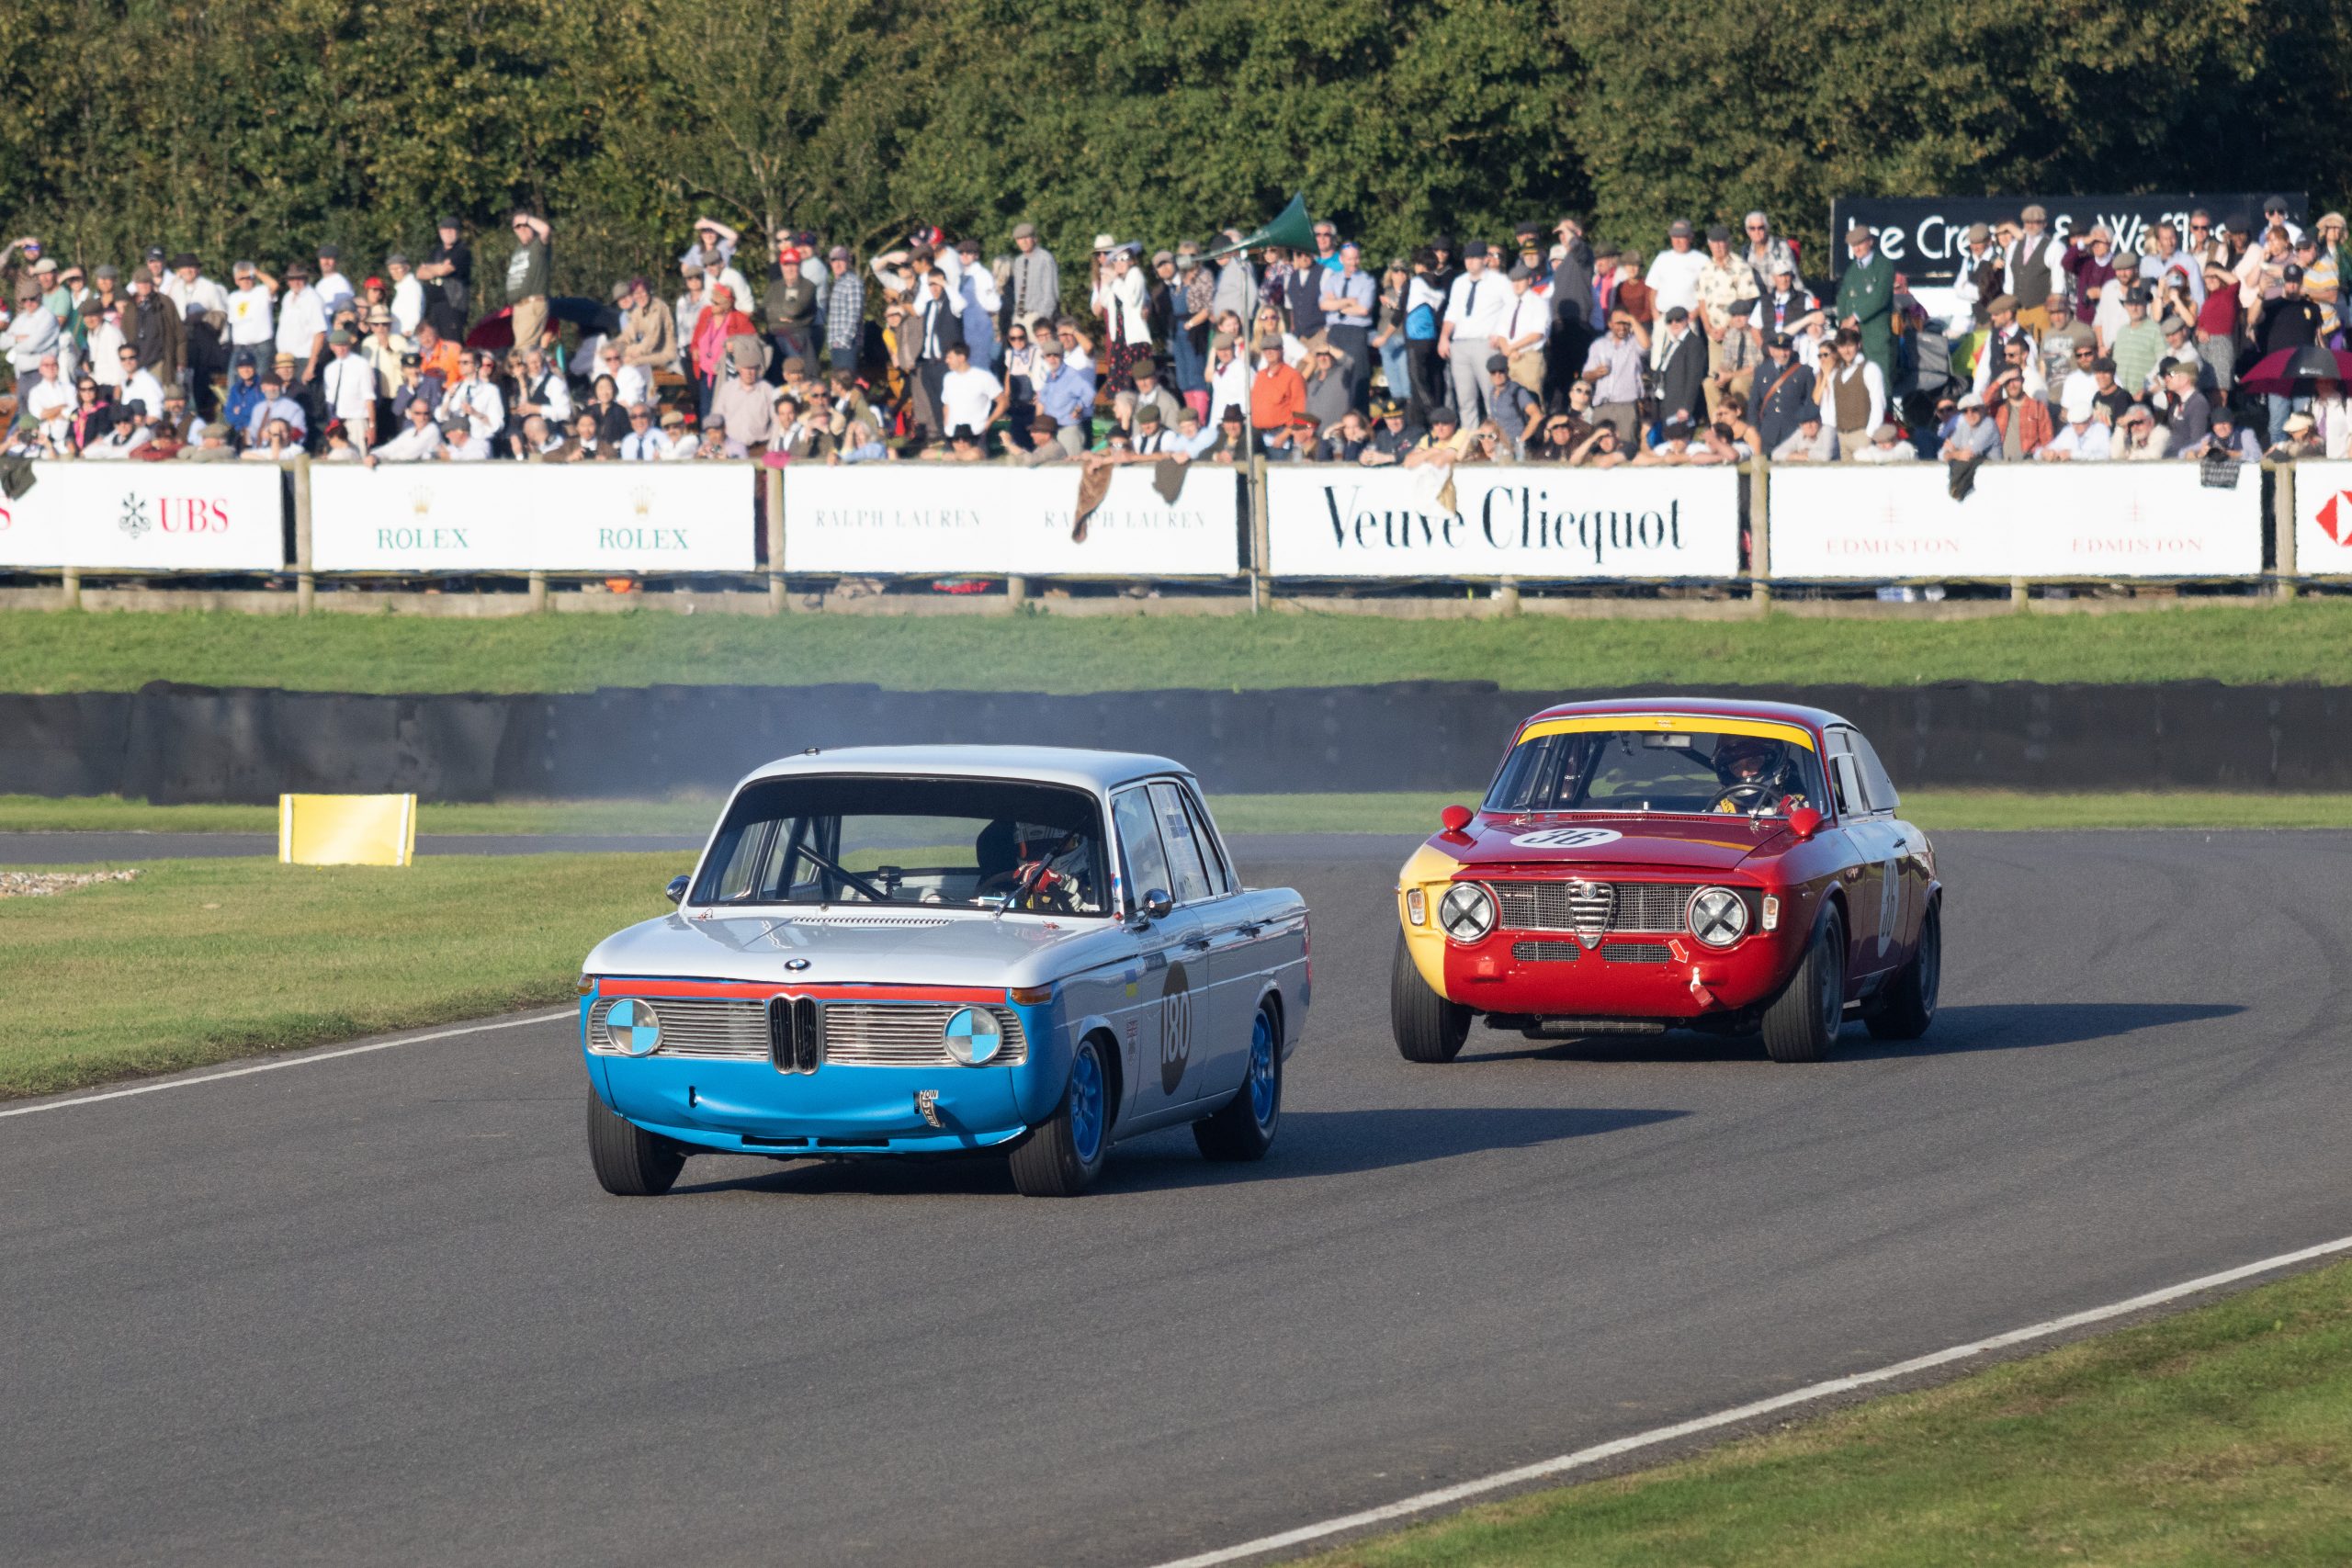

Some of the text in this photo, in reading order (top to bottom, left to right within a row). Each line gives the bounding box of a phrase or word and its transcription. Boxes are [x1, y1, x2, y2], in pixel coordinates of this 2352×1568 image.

[1848, 216, 1905, 259] Ie
[159, 497, 229, 533] UBS
[816, 510, 980, 527] RALPH LAUREN
[1045, 511, 1204, 528] RAPH LAUREN
[1319, 485, 1688, 566] Veuve Clicquot
[377, 528, 469, 550] ROLEX
[599, 528, 688, 550] ROLEX
[1826, 538, 1961, 553] EDMISTON
[2072, 538, 2202, 553] EDMISTON
[1522, 829, 1609, 845] 36
[1161, 991, 1191, 1065] 180
